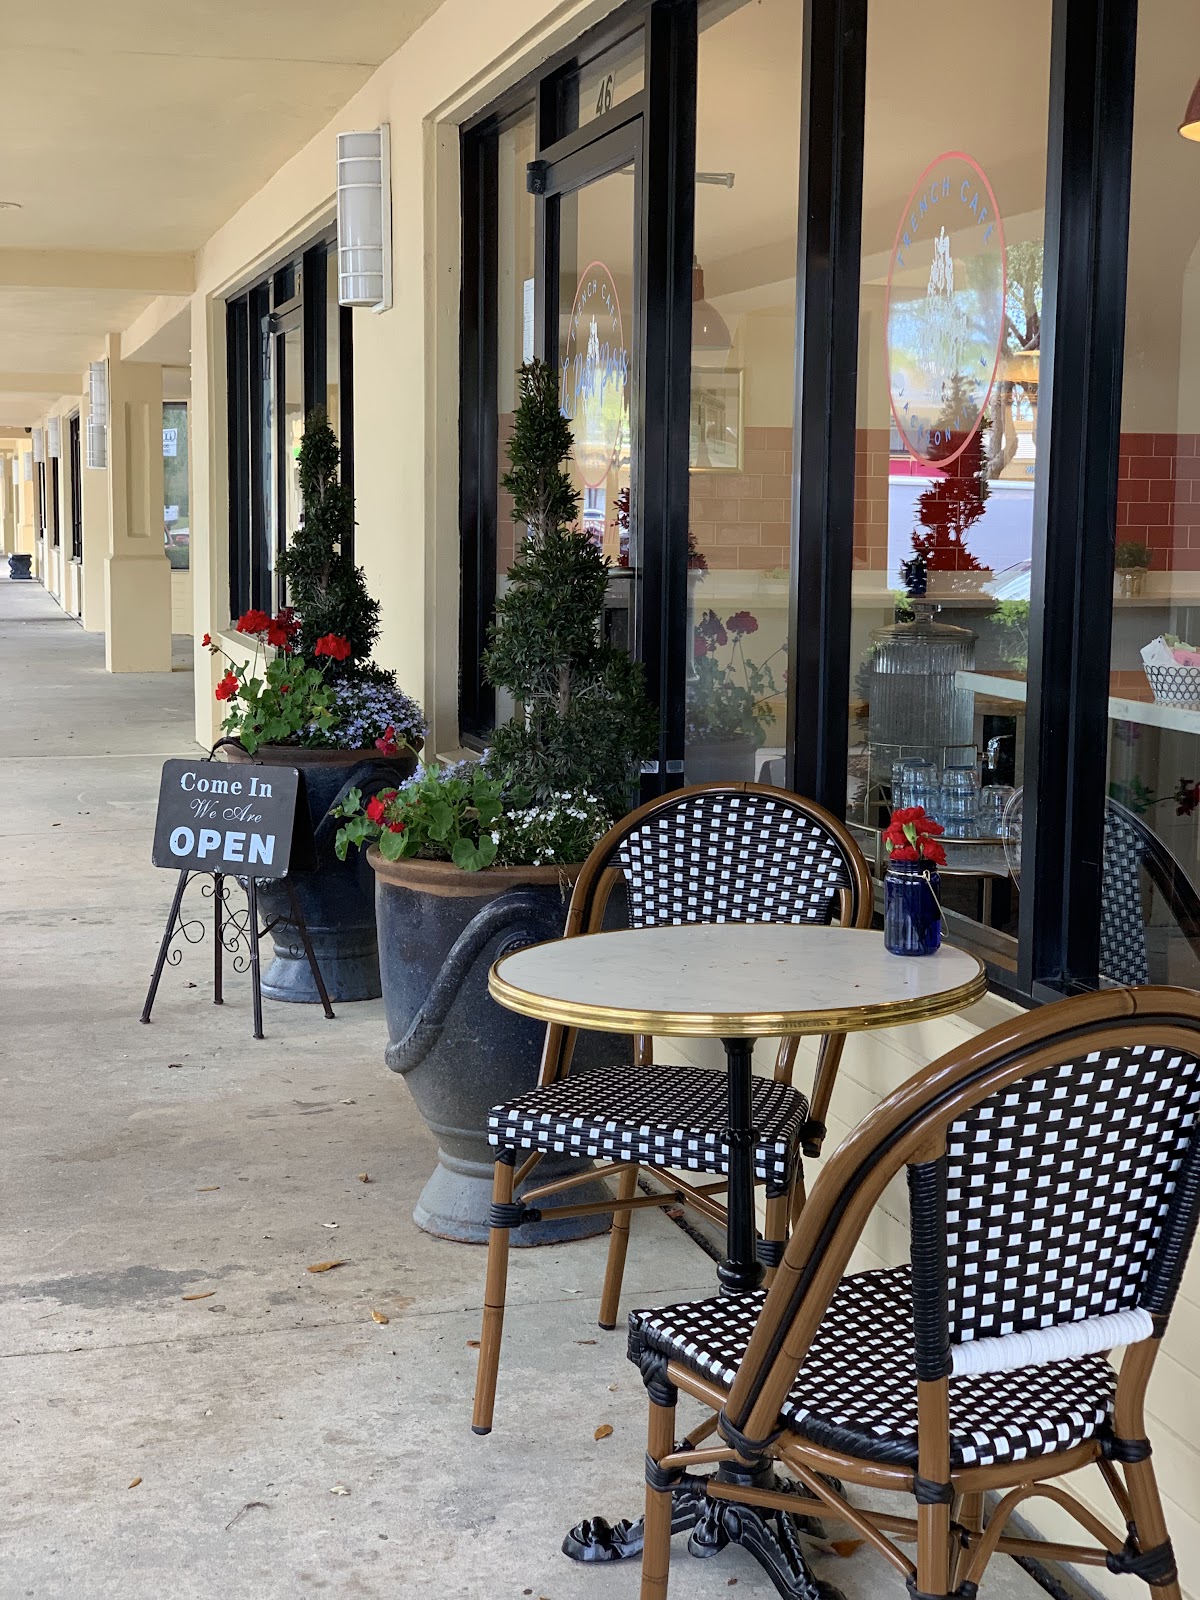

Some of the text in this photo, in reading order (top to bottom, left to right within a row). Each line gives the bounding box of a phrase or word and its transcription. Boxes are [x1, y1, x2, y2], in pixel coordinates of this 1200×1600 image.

[595, 74, 612, 115] 46
[897, 175, 950, 267] FRENCH
[571, 279, 597, 341] FRENCH
[600, 341, 629, 408] Paris
[180, 772, 273, 798] Come In
[190, 798, 262, 823] We Are
[169, 826, 276, 865] OPEN
